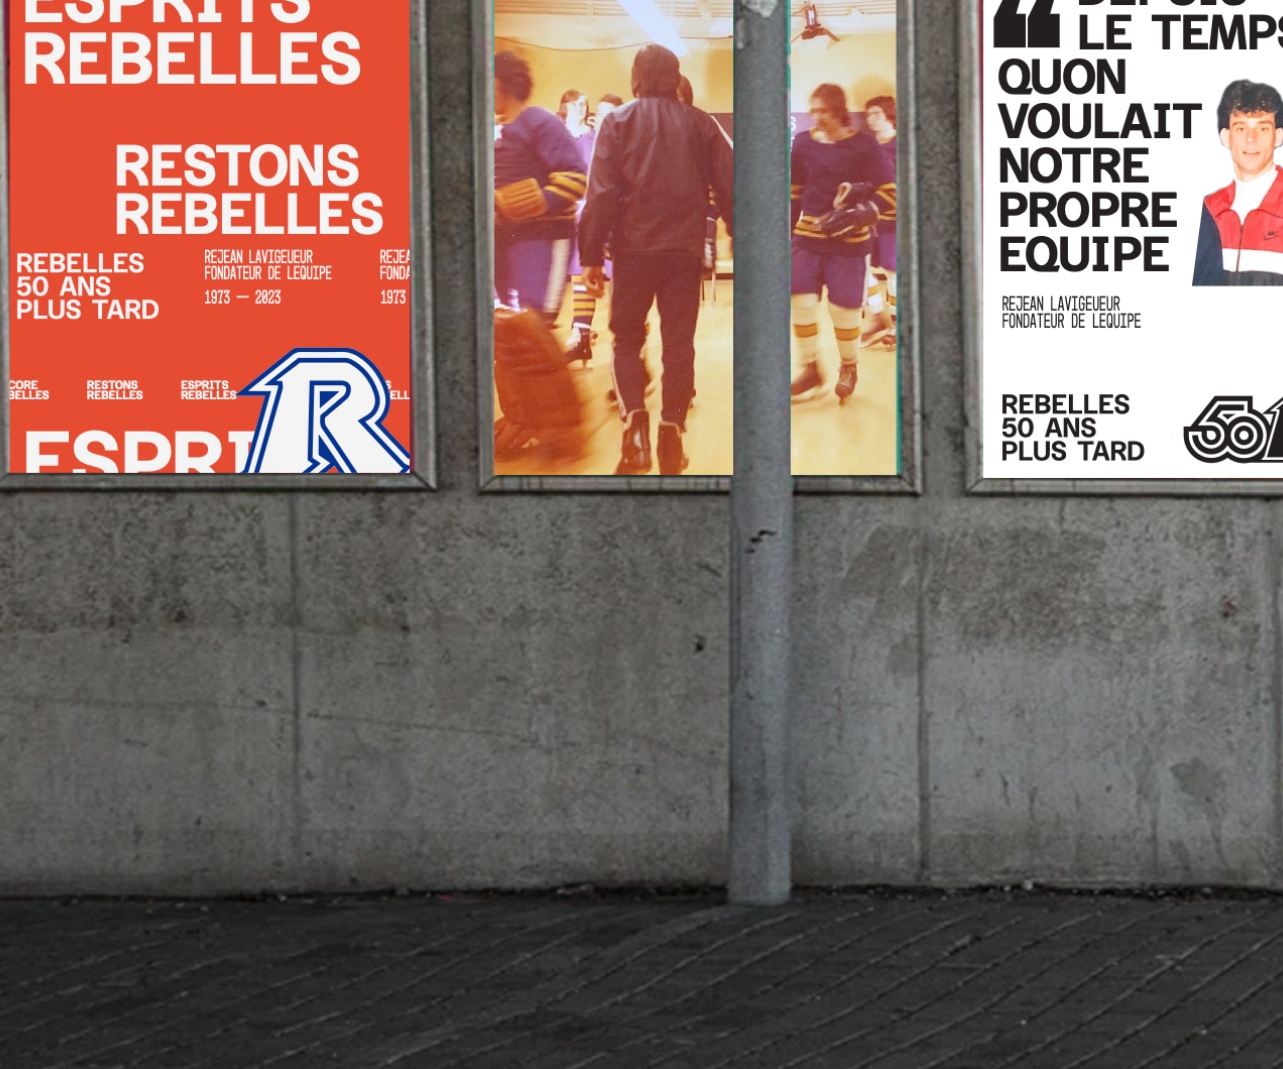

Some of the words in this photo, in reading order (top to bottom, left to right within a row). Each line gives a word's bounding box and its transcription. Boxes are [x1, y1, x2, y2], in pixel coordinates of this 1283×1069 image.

[1080, 15, 1131, 49] LE
[25, 32, 360, 85] REBELLES
[999, 58, 1125, 94] QUON
[998, 103, 1202, 139] VOULAIT
[117, 144, 358, 186] RESTONS
[1000, 147, 1149, 183] NOTRE
[117, 193, 383, 235] REBELLES
[1000, 192, 1177, 227] PROPRE
[17, 253, 144, 273] REBELLES
[205, 250, 242, 263] REJEAN
[249, 249, 312, 263] LAVIGEUEUR
[1001, 236, 1169, 272] EQUIPE
[205, 266, 261, 279] FONDATEUR
[268, 266, 280, 279] DE
[288, 266, 331, 279] LEQUIPE
[17, 276, 48, 296] 50
[60, 276, 110, 296] ANS
[205, 290, 230, 304] 1973
[256, 290, 280, 304] 2023
[381, 290, 406, 304] 1973
[1003, 296, 1043, 311] REJEAN
[1051, 296, 1120, 311] LAVIGEUEUR
[17, 299, 81, 319] PLUS
[92, 300, 159, 319] TARD
[1003, 313, 1064, 328] FONDATEUR
[1072, 313, 1085, 328] DE
[1093, 313, 1140, 328] LEQUIPE
[87, 380, 138, 389] RESTONS
[87, 390, 143, 399] REBELLES
[182, 380, 228, 389] ESPRITS
[181, 390, 237, 400] REBELLES
[1003, 394, 1129, 414] REBELLES
[1002, 417, 1034, 437] 50
[1045, 417, 1096, 437] ANS
[1003, 441, 1066, 461] PLUS
[1078, 441, 1144, 460] TARD
